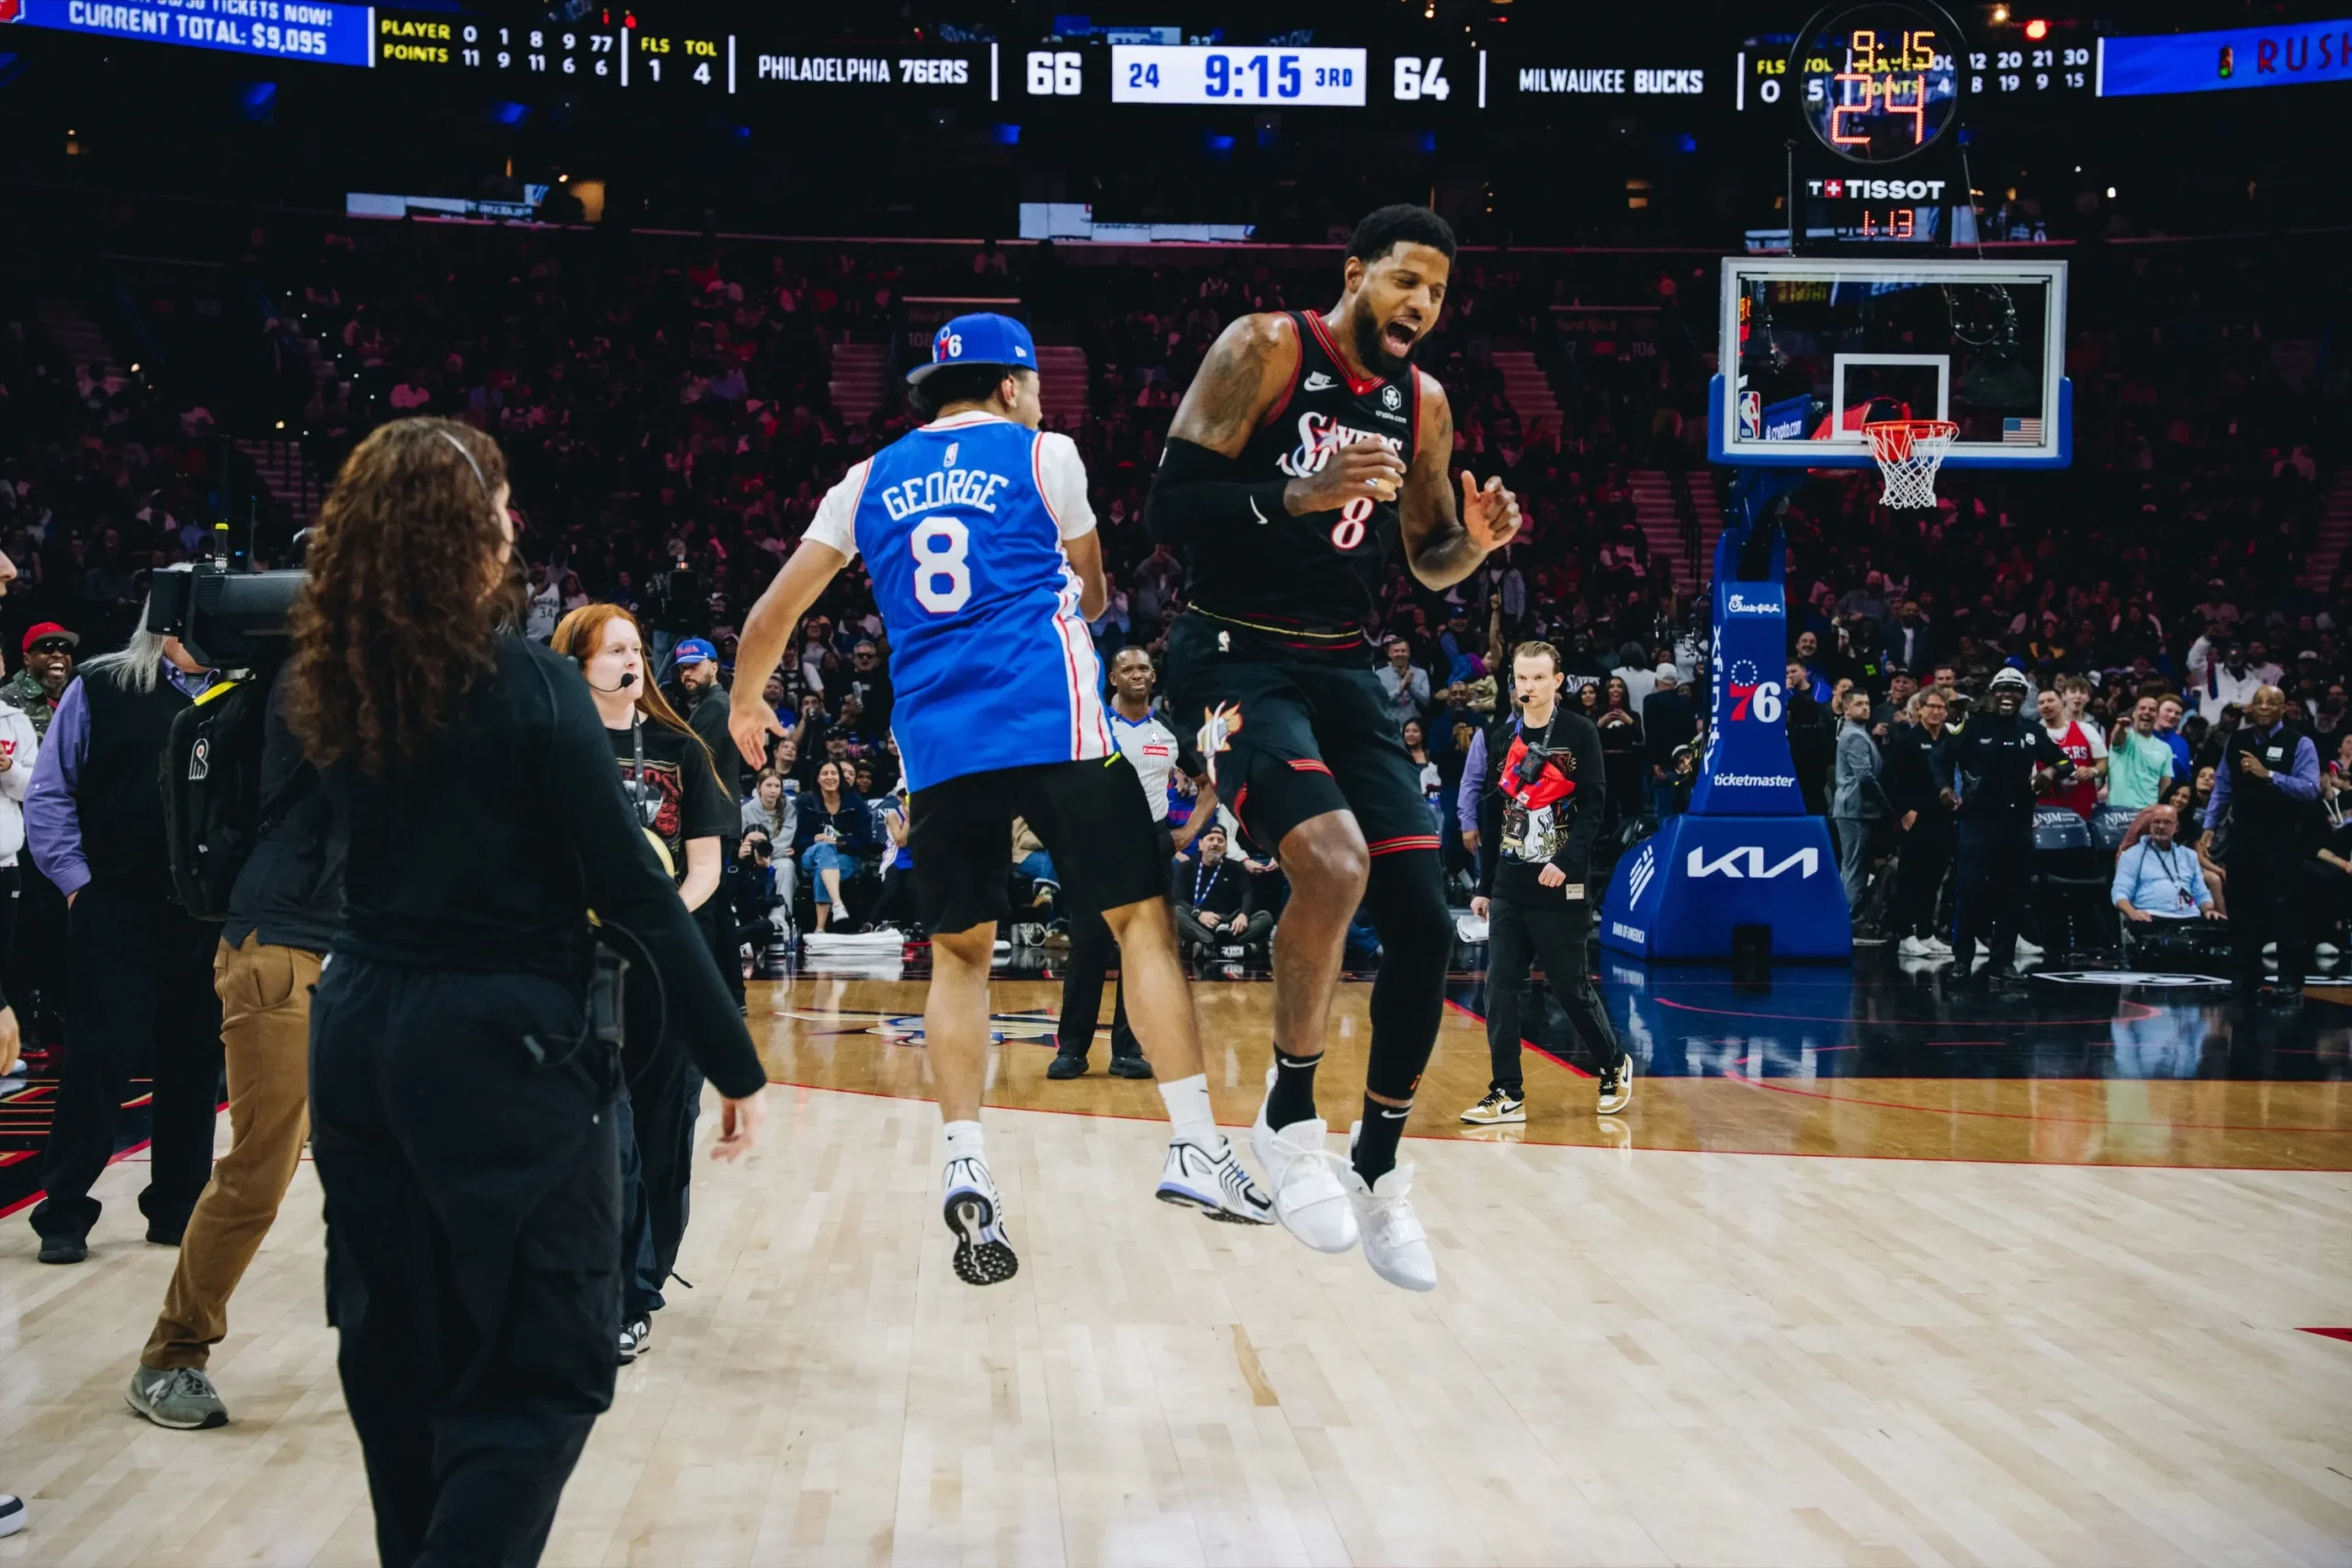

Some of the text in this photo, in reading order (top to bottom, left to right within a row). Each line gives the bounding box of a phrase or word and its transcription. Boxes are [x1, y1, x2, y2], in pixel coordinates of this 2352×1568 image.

[69, 1, 327, 55] CURRENT TOTAL: $9,095
[284, 4, 333, 27] NOW!
[381, 19, 613, 52] PLAYER 0 1 8 9 77
[641, 37, 718, 57] FLS TOL
[1852, 30, 1936, 69] 9:15
[383, 43, 608, 76] POINTS 11 9 11 6 6
[649, 60, 711, 85] 1 4
[758, 54, 968, 84] PHILADELPHIA 76ERS
[1757, 59, 1786, 74] FLS
[1996, 51, 2022, 69] 20
[2031, 49, 2053, 68] 21
[2063, 48, 2089, 66] 30
[1026, 51, 1082, 96] 66
[1128, 54, 1353, 98] 24 9:15 3RD
[1394, 57, 1450, 101] 64
[1520, 68, 1704, 94] MILWAUKEE BUCKS
[1937, 77, 1951, 93] 4
[1998, 74, 2020, 92] 19
[2036, 73, 2049, 91] 9
[2064, 73, 2085, 89] 15
[1759, 78, 1825, 104] 0 5
[1831, 73, 1926, 145] 24
[1845, 180, 1946, 199] TISSOT
[1863, 209, 1913, 238] 1:13
[938, 333, 964, 361] 76
[1632, 341, 1657, 356] 106
[1308, 370, 1332, 385] NIKE
[1375, 410, 1408, 424] crypto.com
[881, 469, 1010, 521] GEORGE
[1331, 496, 1374, 549] 8
[910, 516, 972, 614] 8
[1729, 682, 1782, 723] 76
[1713, 773, 1795, 788] ticketmaster
[1687, 845, 1818, 879] KIA
